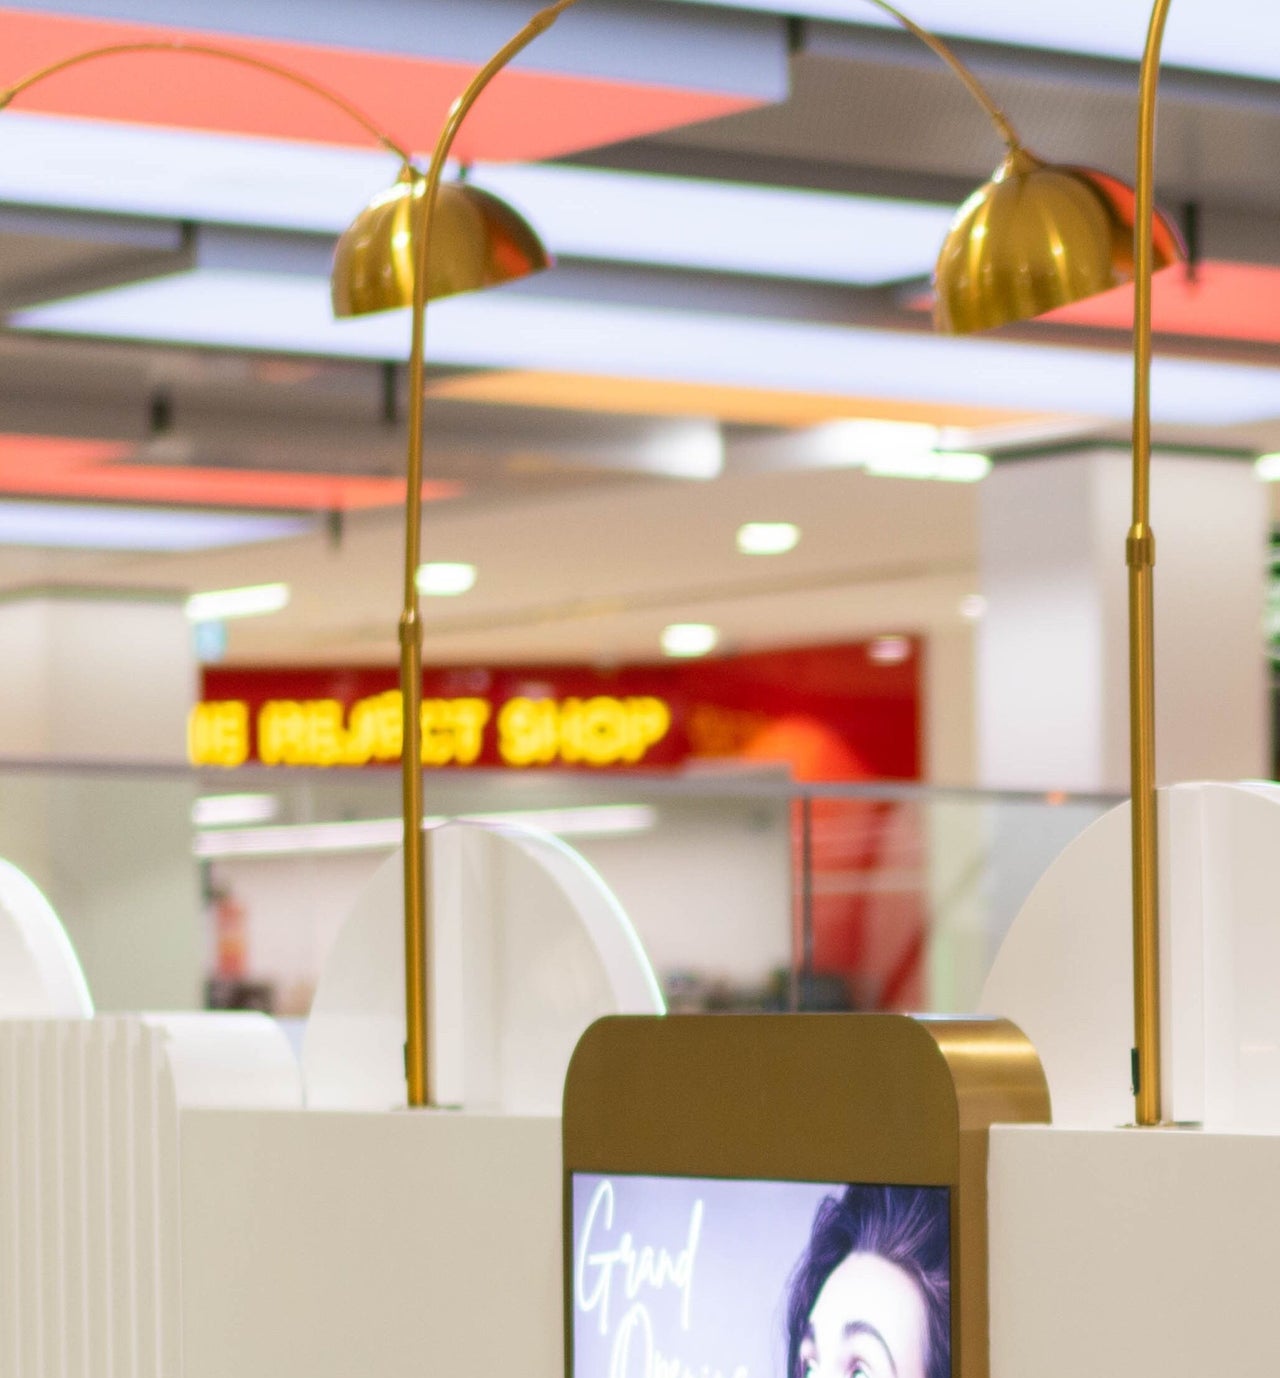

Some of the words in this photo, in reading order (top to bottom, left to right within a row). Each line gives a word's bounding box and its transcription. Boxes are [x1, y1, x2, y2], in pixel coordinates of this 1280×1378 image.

[258, 689, 489, 766] REJECT
[498, 696, 670, 765] SHOP
[579, 1180, 703, 1335] Grand
